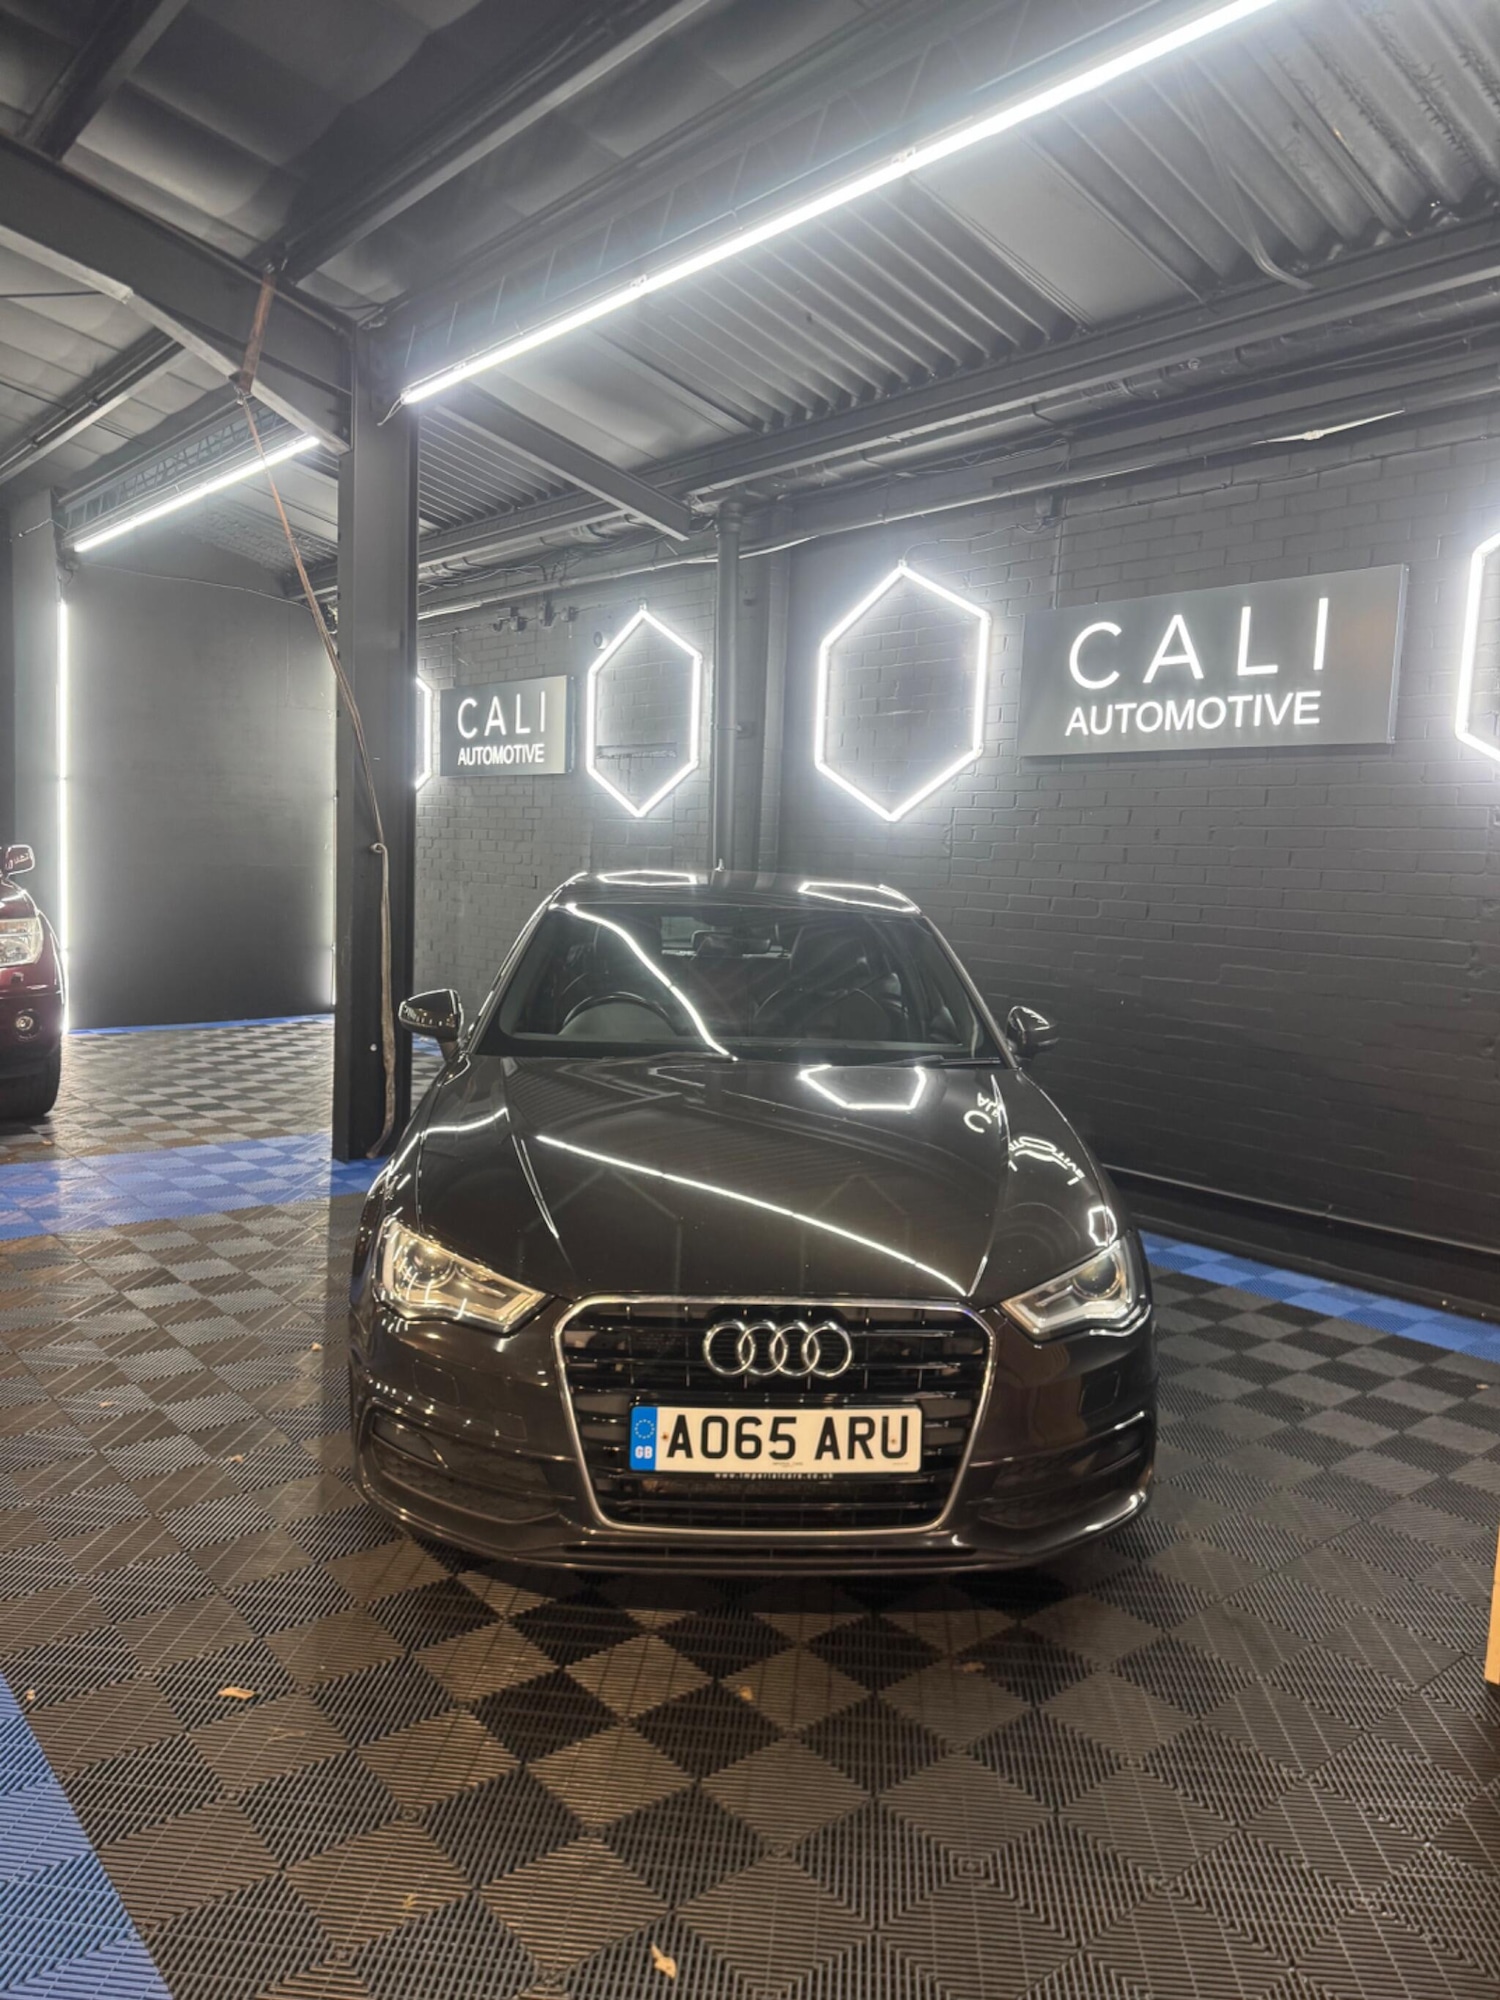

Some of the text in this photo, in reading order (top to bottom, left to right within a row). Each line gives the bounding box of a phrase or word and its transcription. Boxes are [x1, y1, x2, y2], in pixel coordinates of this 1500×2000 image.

[1069, 597, 1329, 689] CALI
[457, 691, 546, 739] CALI
[1065, 690, 1321, 736] AUTOMOTIVE
[457, 743, 545, 766] AUTOMOTIVE
[635, 1445, 653, 1459] GB
[666, 1414, 909, 1460] AO65 ARU
